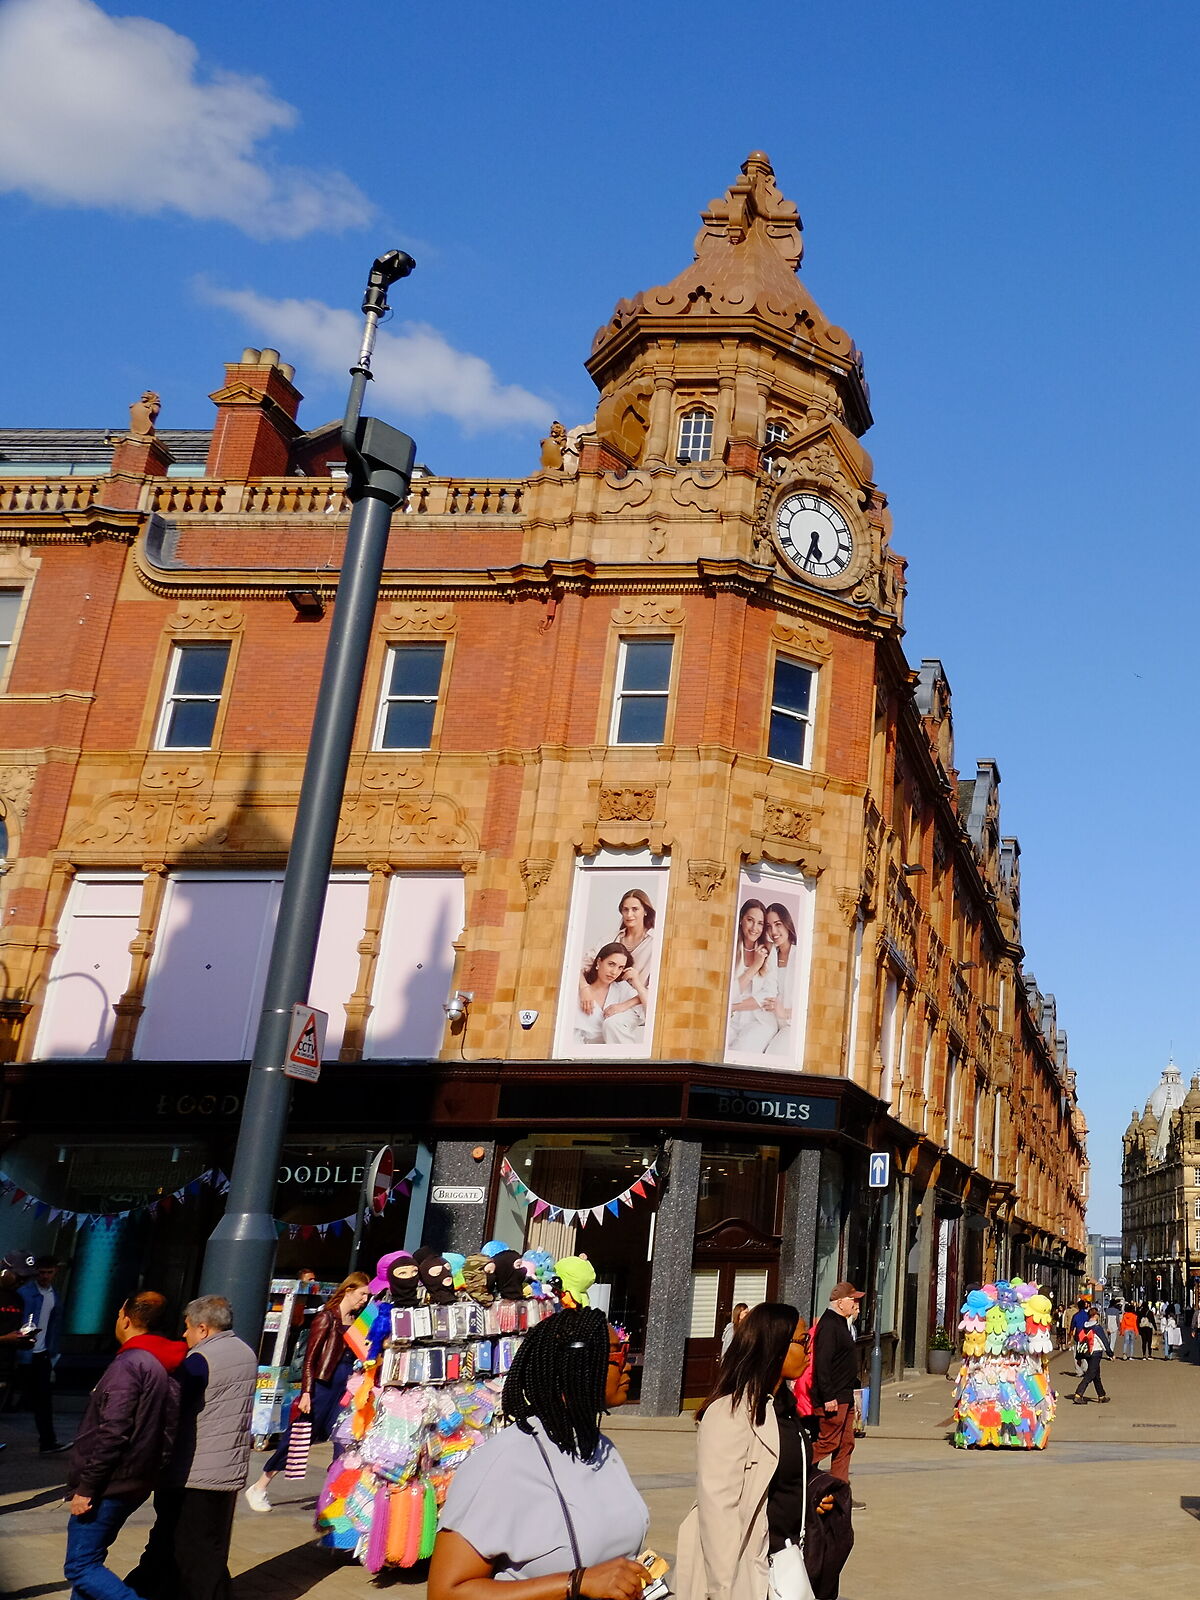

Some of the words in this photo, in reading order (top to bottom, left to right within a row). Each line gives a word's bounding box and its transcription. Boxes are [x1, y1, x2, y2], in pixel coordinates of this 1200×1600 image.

[298, 1041, 318, 1055] CCTV
[718, 1096, 811, 1121] BOODLES
[437, 1189, 480, 1200] BRIGGATE
